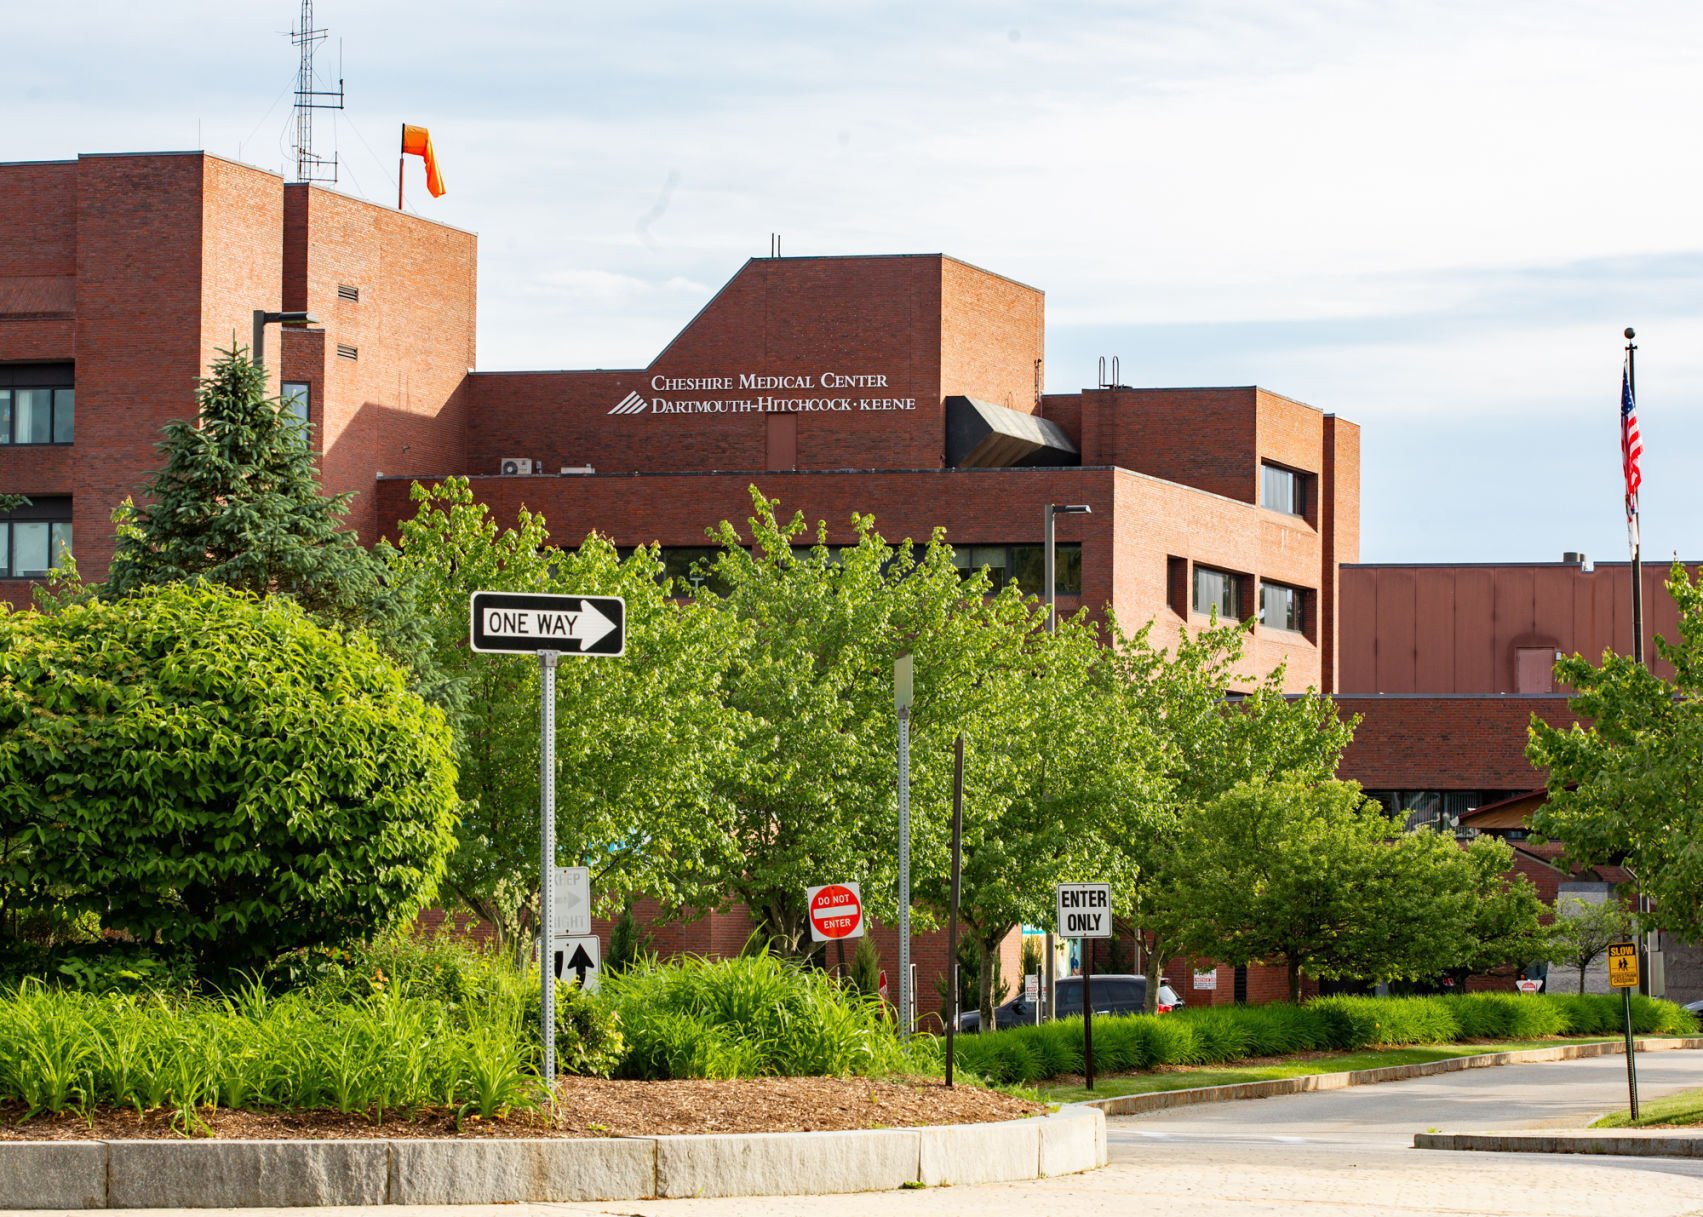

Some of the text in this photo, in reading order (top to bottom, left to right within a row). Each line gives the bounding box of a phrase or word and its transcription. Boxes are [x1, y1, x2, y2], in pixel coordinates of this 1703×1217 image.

[859, 398, 916, 410] KEENE
[489, 611, 578, 636] ONE WAY
[817, 894, 850, 906] DO NOT
[1061, 890, 1107, 908] ENTER
[554, 914, 585, 929] IGHT
[823, 918, 851, 929] ENTER
[1067, 913, 1102, 932] ONLY
[1610, 946, 1634, 956] SLOW
